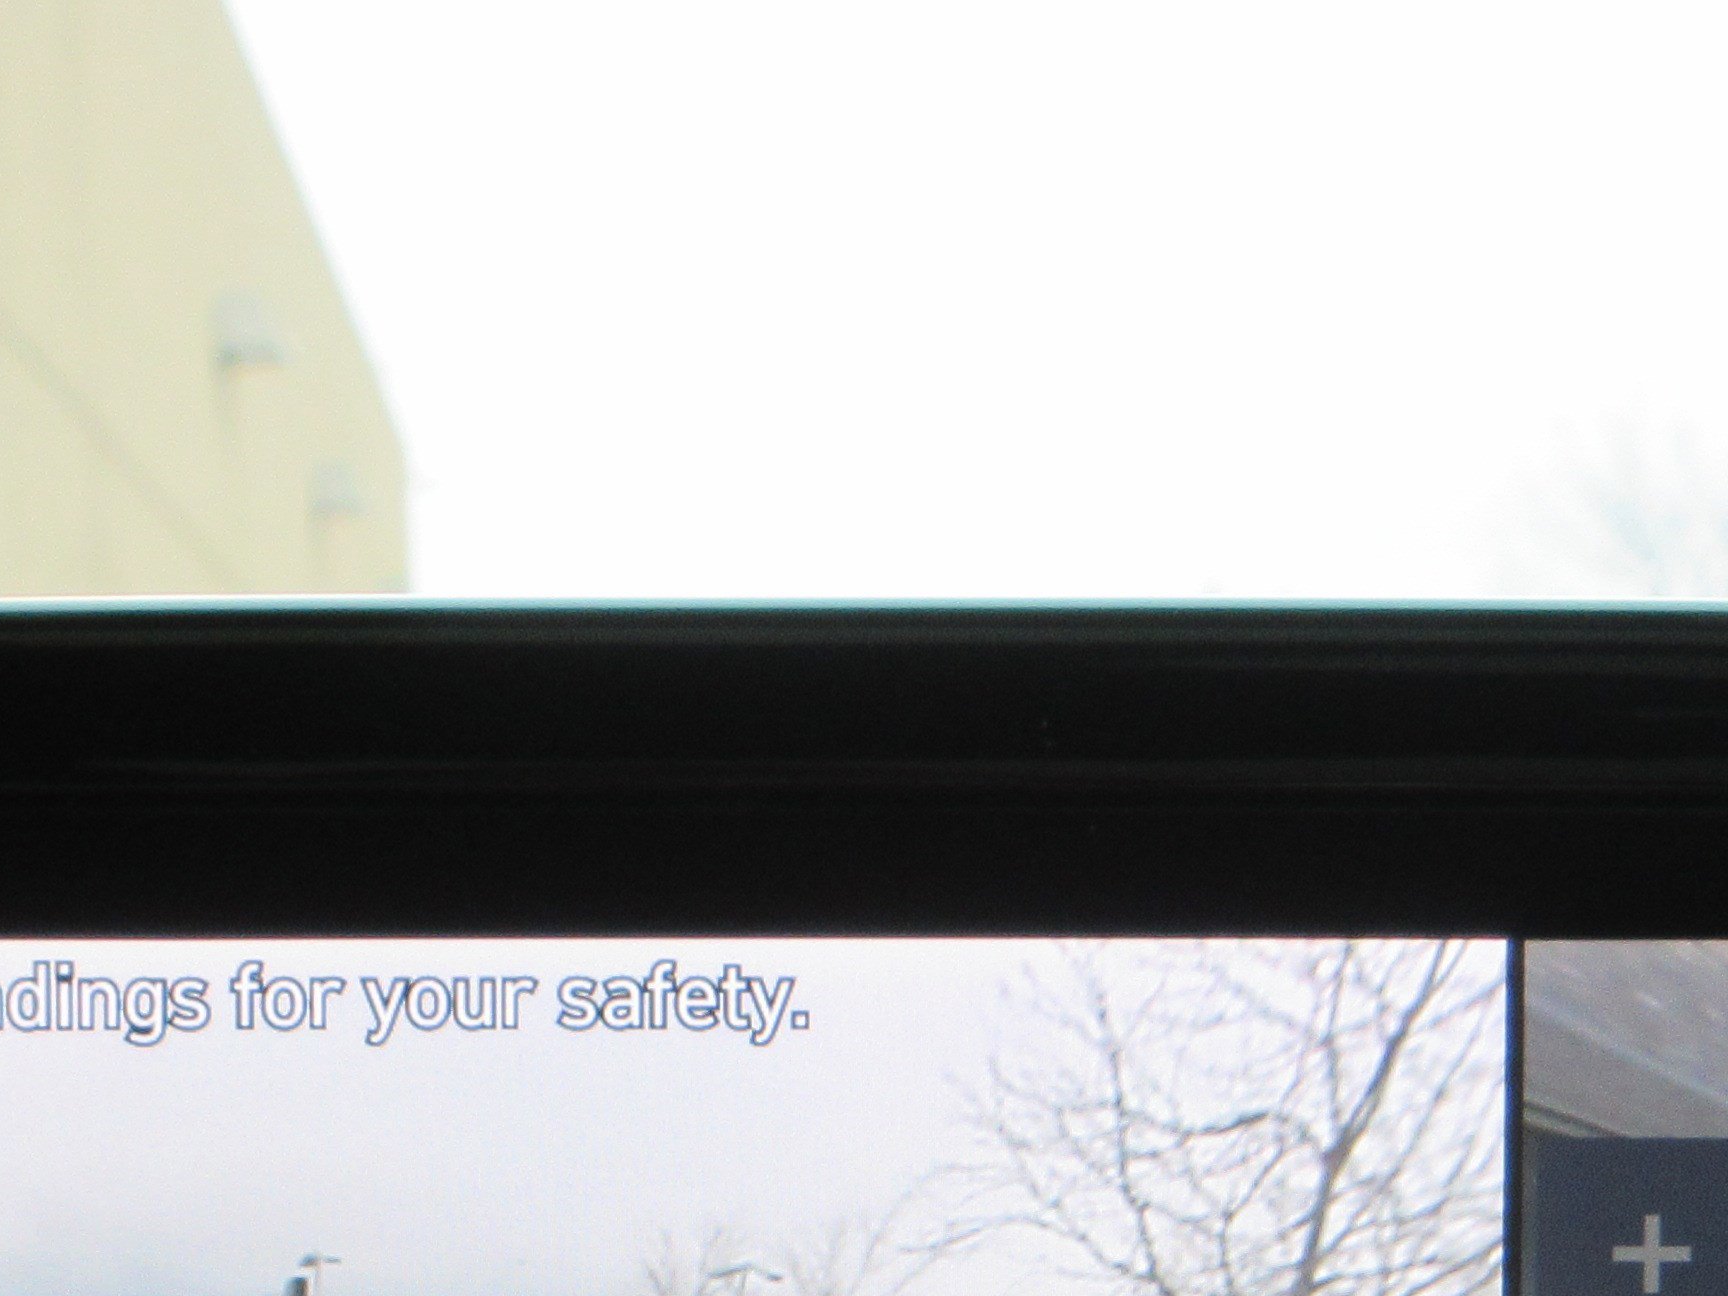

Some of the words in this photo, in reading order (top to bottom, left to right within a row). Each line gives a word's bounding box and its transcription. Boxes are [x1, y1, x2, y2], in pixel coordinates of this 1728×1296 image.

[229, 959, 346, 1032] for
[359, 976, 539, 1047] your
[556, 959, 812, 1047] safety.
